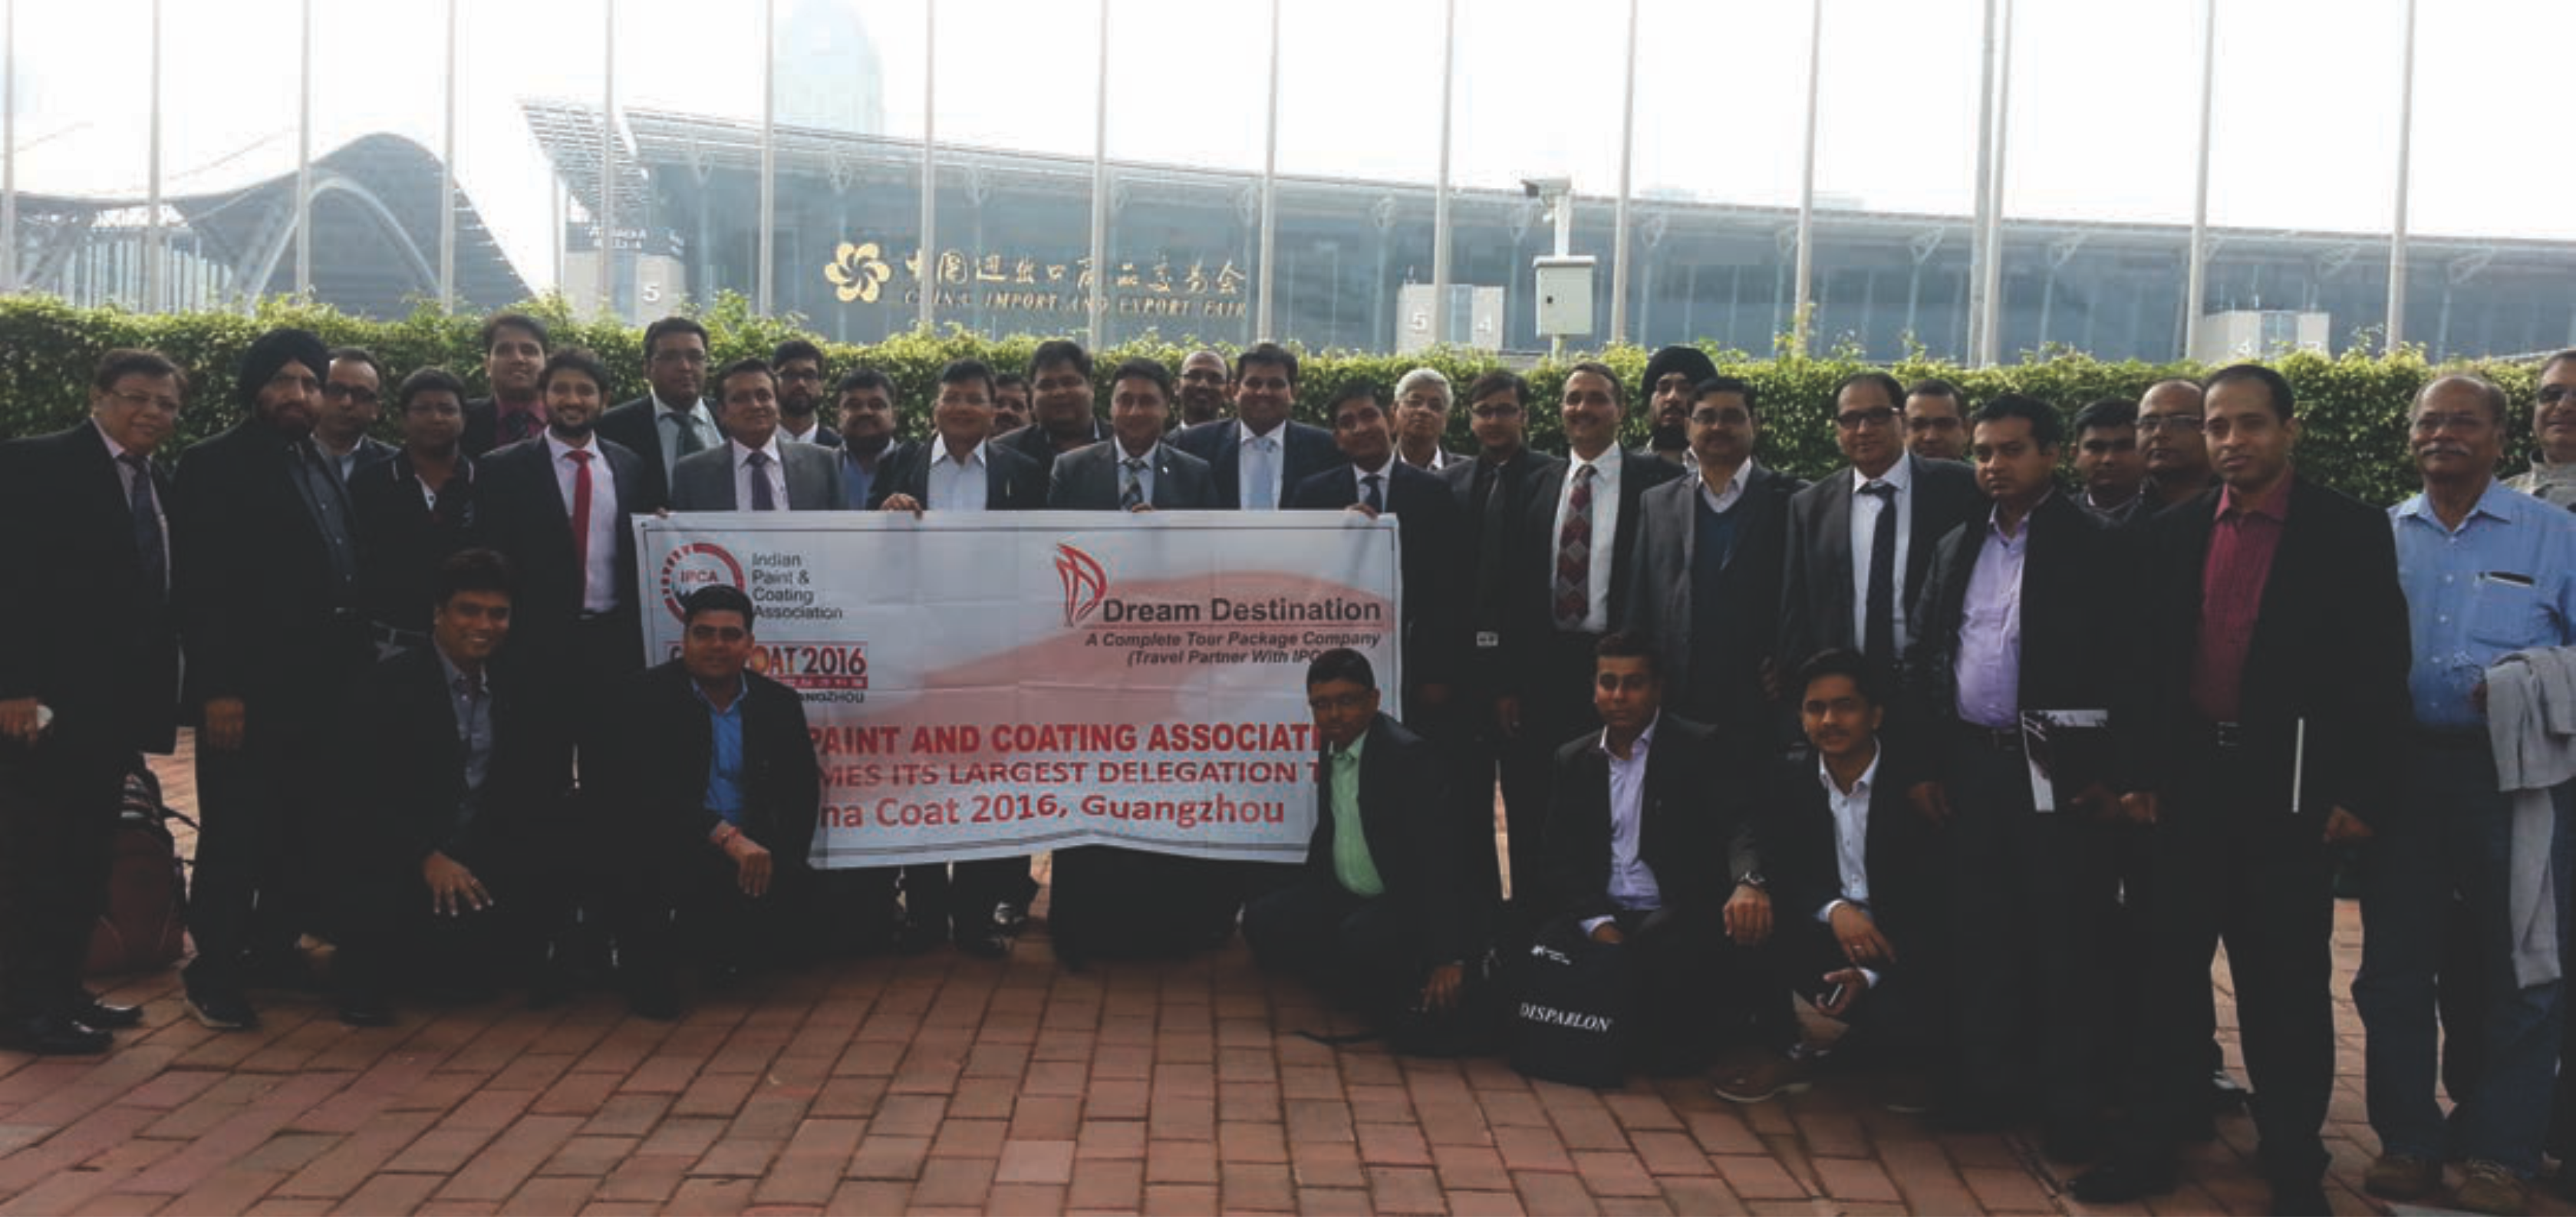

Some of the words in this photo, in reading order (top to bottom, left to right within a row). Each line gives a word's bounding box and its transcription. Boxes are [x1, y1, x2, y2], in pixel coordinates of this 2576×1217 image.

[641, 281, 661, 302] 5
[905, 289, 970, 305] CINA
[985, 291, 1058, 308] IMPORT
[1119, 297, 1189, 316] EXPORT
[1204, 300, 1247, 317] FAIR
[1412, 312, 1428, 331] 5
[752, 552, 802, 567] Indian
[680, 569, 719, 583] IPCA
[752, 569, 793, 585] Paint
[798, 570, 810, 585] &
[752, 586, 814, 605] Coating
[752, 605, 843, 620] Association
[1102, 599, 1201, 623] Dream
[1210, 596, 1382, 622] Destination
[1085, 633, 1099, 647] A
[1102, 632, 1181, 651] Complete
[1188, 632, 1225, 647] Tour
[1227, 632, 1299, 650] Package
[1303, 631, 1382, 649] Company
[1127, 650, 1184, 668] (Travel
[1188, 650, 1247, 665] Partner
[1251, 649, 1290, 664] With
[1292, 648, 1321, 664] IPC
[911, 724, 981, 754] AND
[990, 724, 1138, 753] COATING
[1147, 723, 1321, 753] ASSOCIATI
[892, 764, 940, 786] ITS
[949, 761, 1088, 786] LARGEST
[1098, 760, 1298, 784] DELEGATION
[1306, 760, 1319, 784] T
[875, 797, 961, 827] Coat
[970, 793, 1069, 824] 2016,
[1081, 793, 1286, 830] Guangzhou
[1520, 1002, 1613, 1032] DISPARLON
